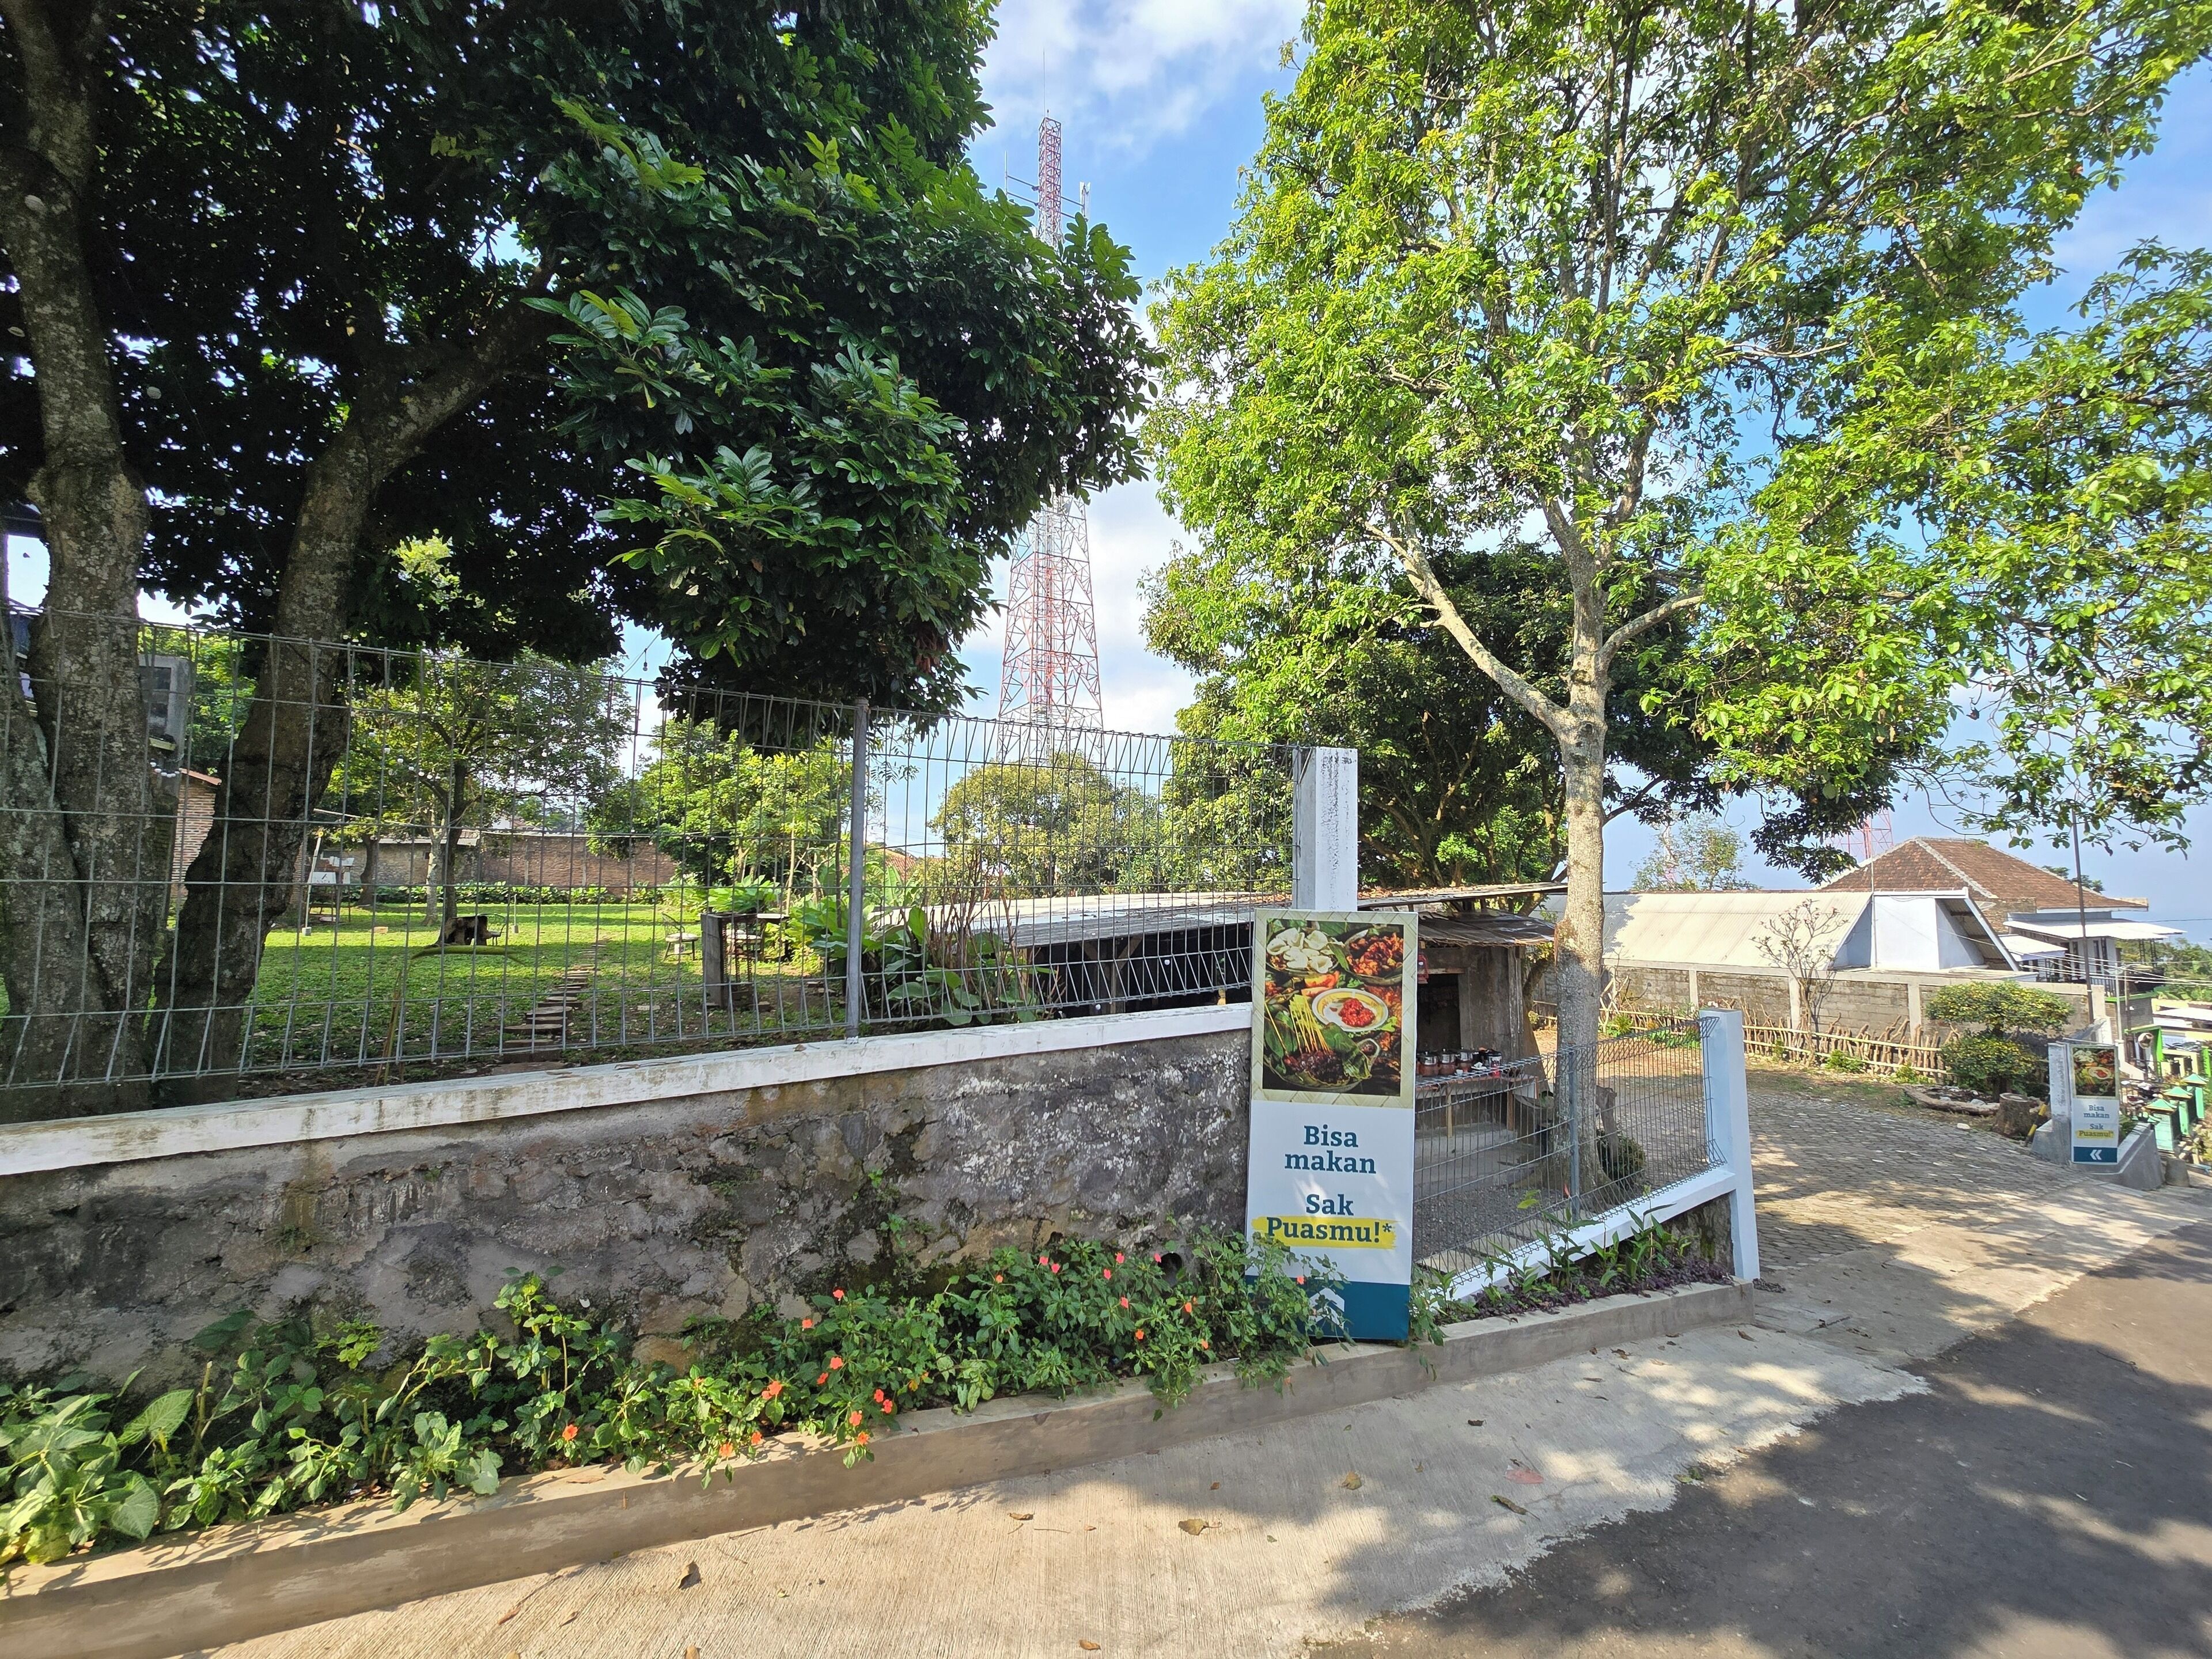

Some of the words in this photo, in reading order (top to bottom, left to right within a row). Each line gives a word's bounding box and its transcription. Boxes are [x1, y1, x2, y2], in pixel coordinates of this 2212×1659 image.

[1304, 1124, 1358, 1147] Bisa
[1285, 1150, 1376, 1173] makan
[1306, 1194, 1354, 1215] Sak
